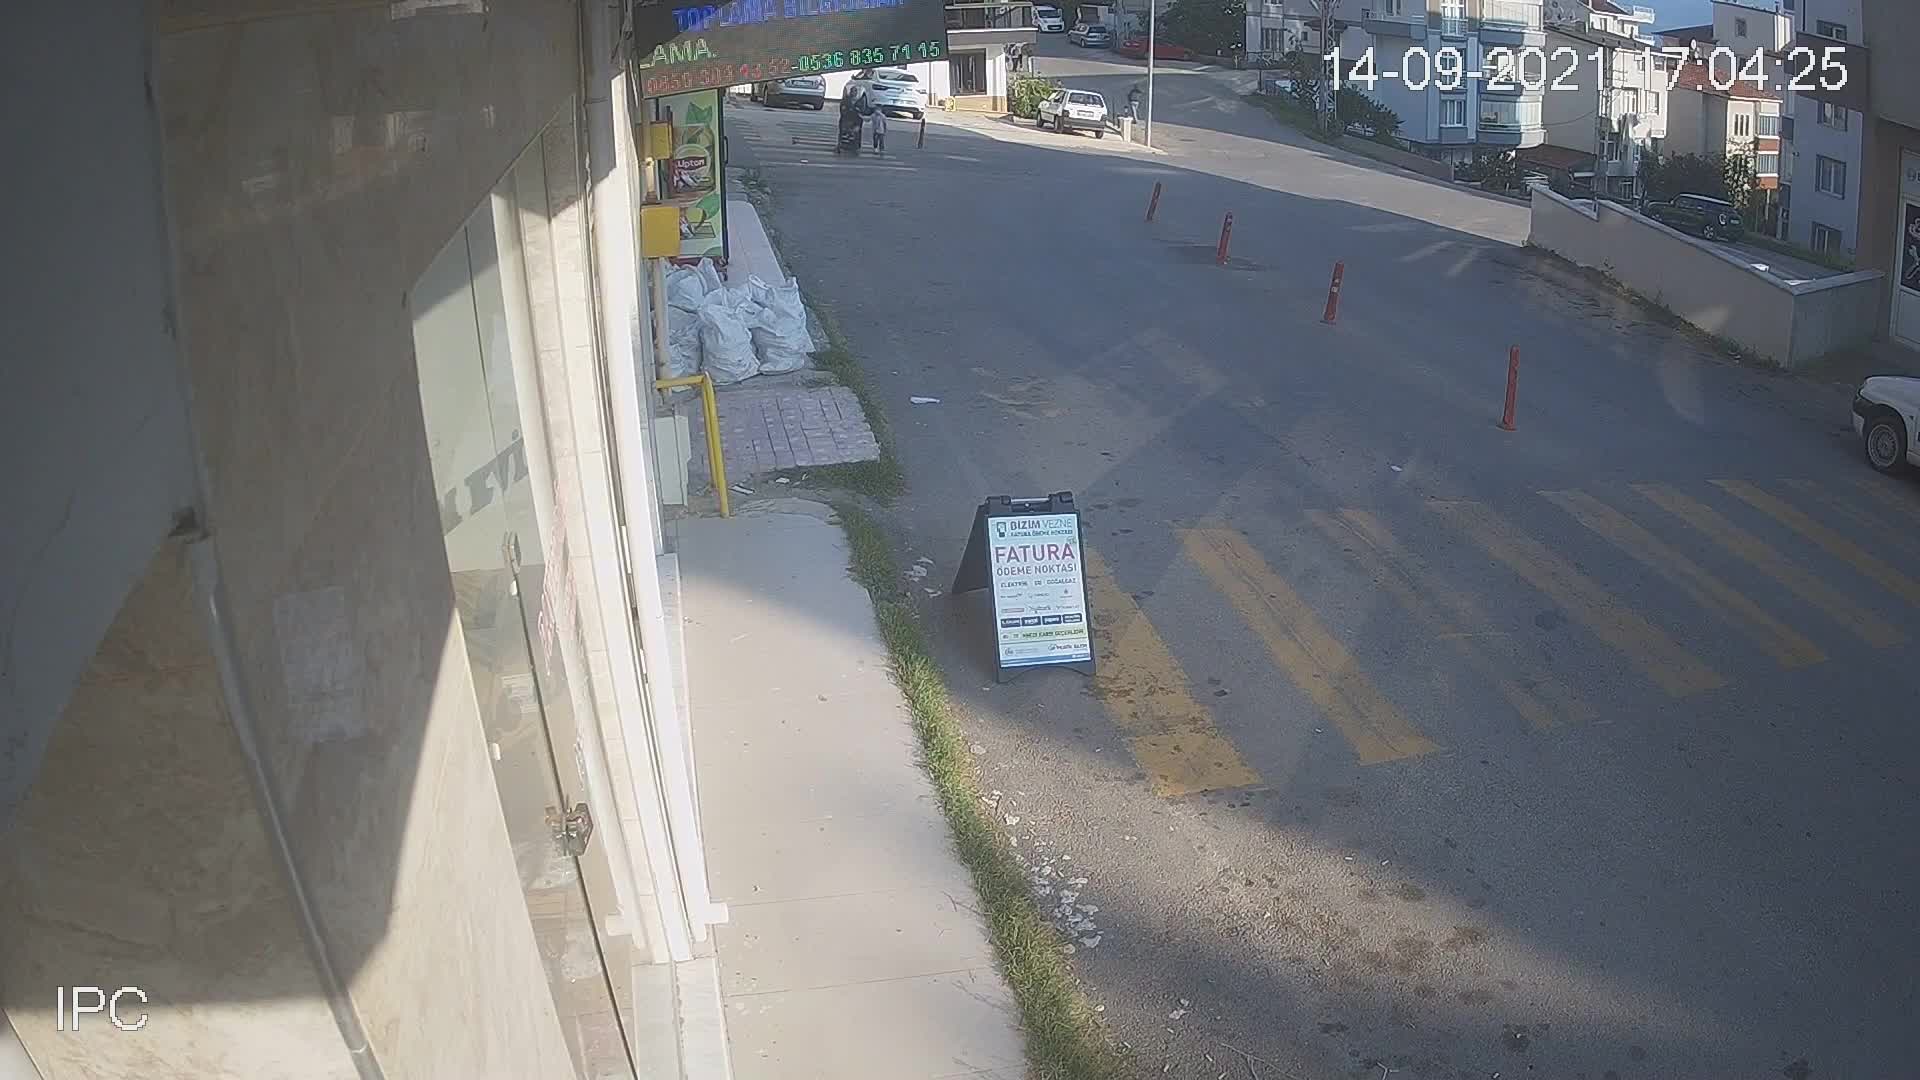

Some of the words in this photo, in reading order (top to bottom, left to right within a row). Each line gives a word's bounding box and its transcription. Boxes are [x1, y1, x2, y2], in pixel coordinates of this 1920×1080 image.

[640, 37, 718, 69] AMA.
[1042, 519, 1072, 528] VEZNE
[995, 543, 1075, 563] FATURA
[997, 565, 1032, 576] ÖDEME
[1035, 563, 1077, 574] NOKTASI
